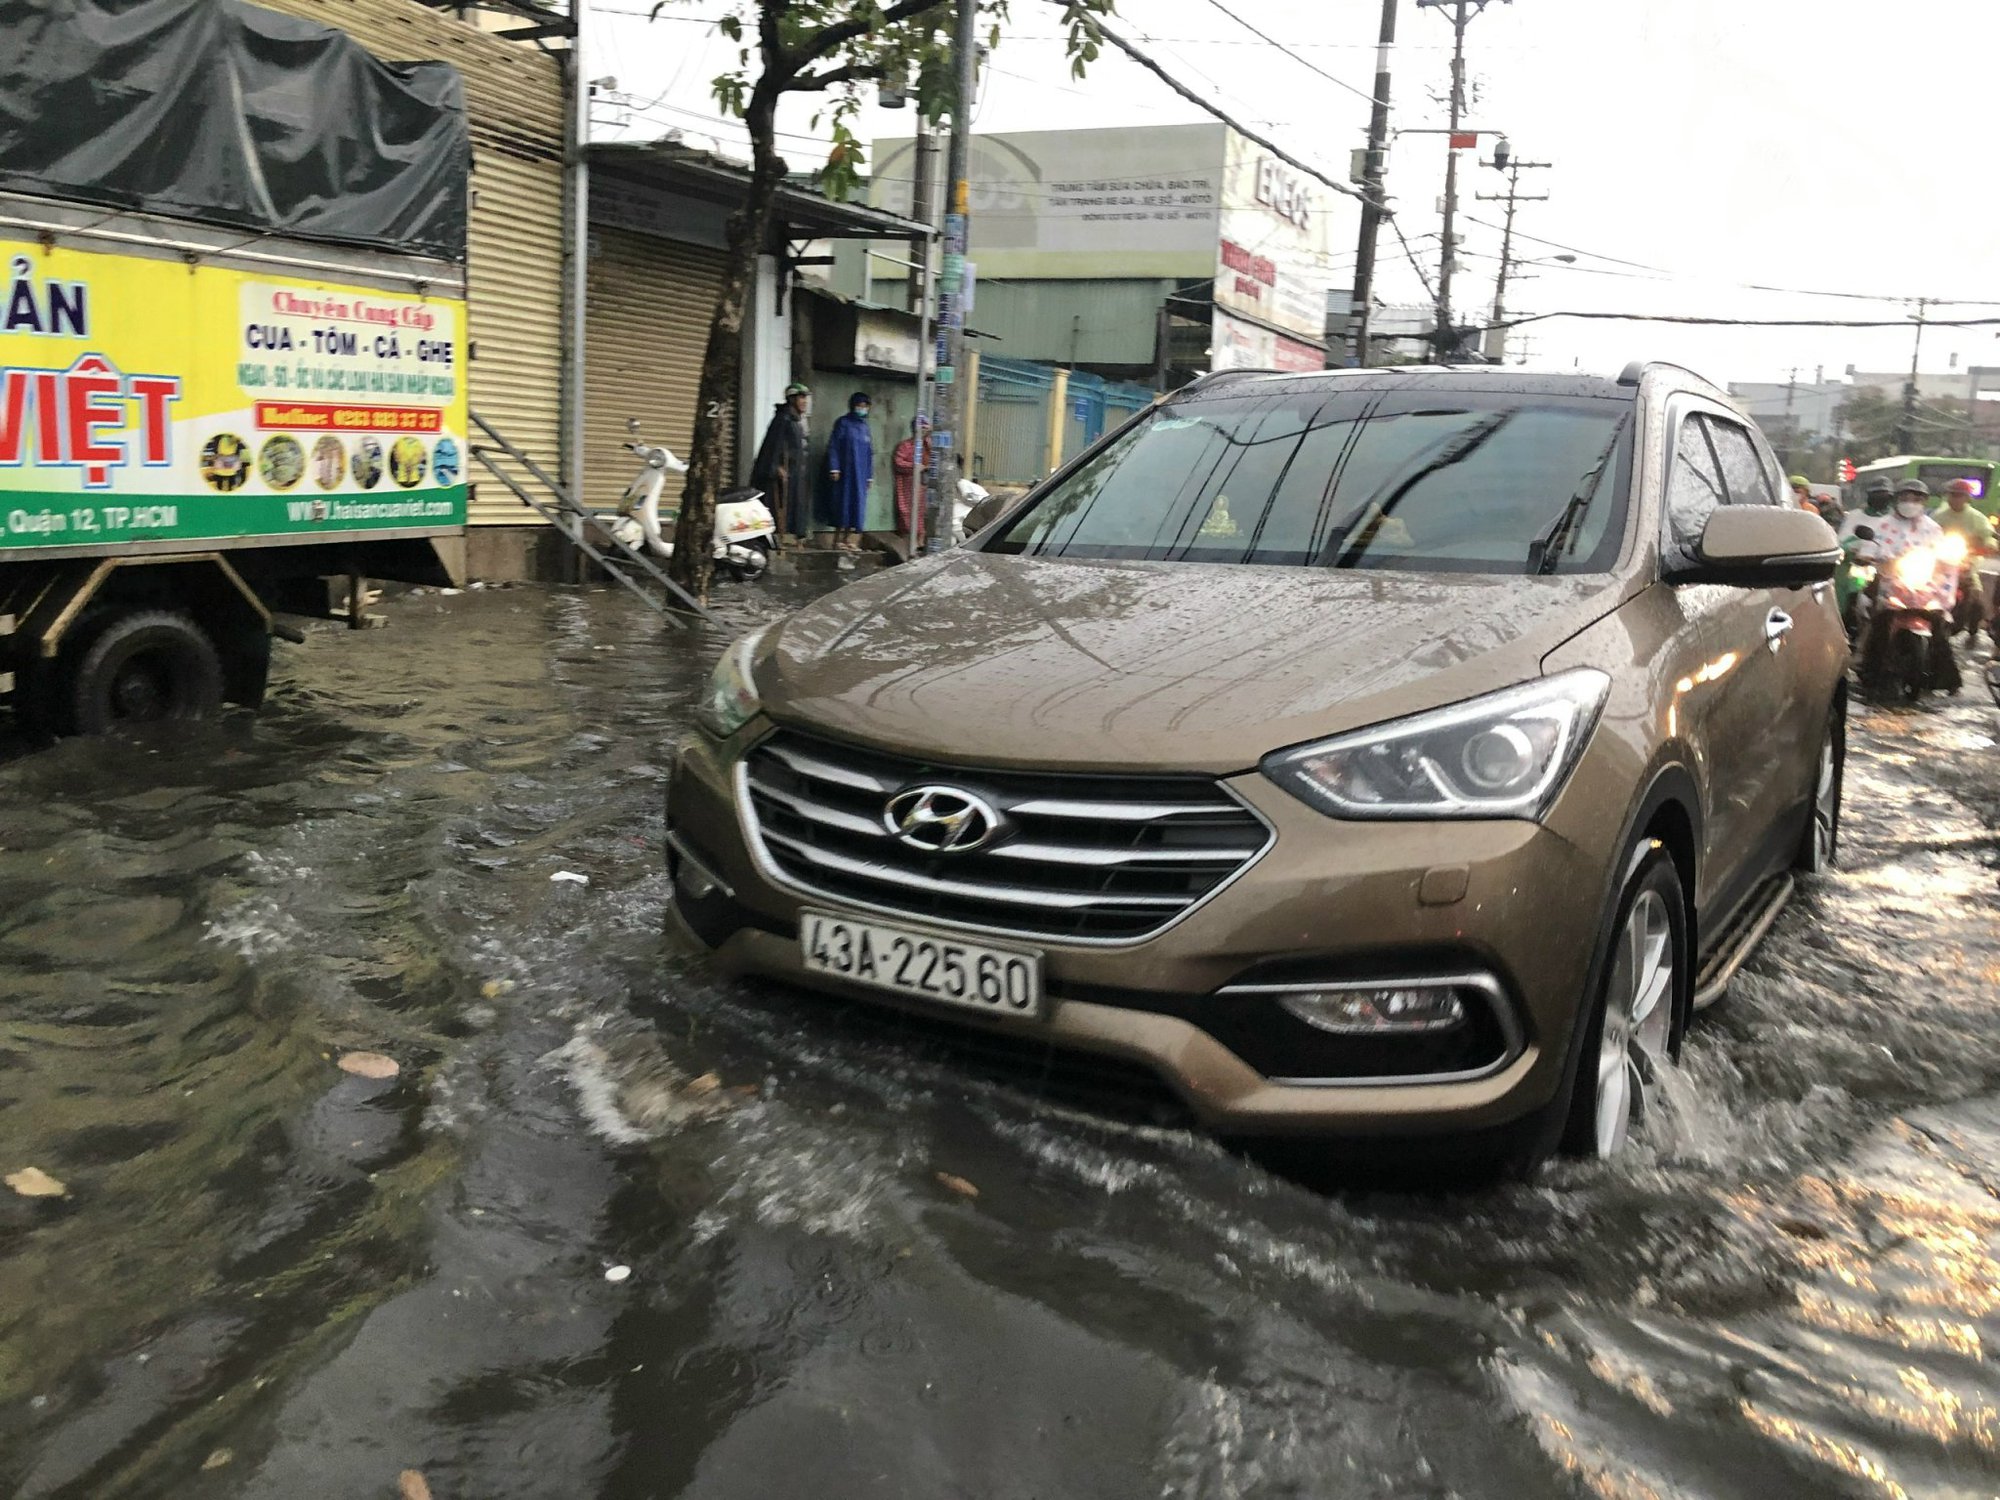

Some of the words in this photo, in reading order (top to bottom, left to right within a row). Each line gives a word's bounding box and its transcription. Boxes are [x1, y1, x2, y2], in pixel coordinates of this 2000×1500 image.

[272, 292, 349, 320] Chuyên
[353, 301, 399, 327] Cung
[246, 323, 293, 351] CUA
[312, 326, 357, 356] TÔM
[375, 331, 401, 359] CÁ
[417, 339, 454, 370] GHẸ
